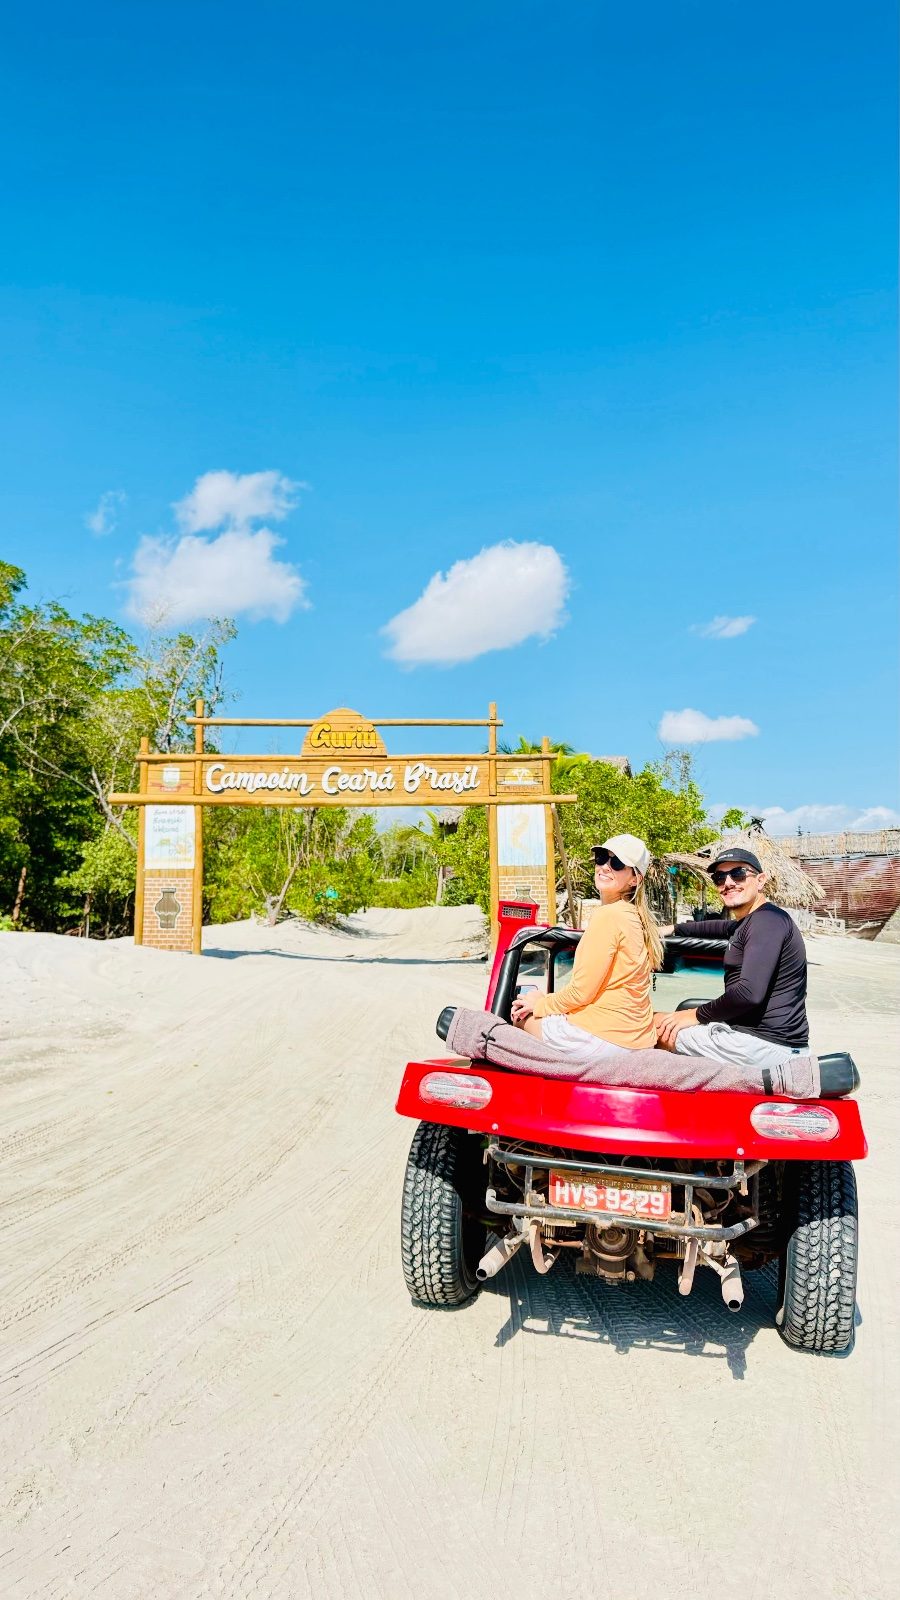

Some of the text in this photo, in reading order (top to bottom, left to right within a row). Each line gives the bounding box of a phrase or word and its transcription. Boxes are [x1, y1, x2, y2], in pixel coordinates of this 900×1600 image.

[310, 722, 378, 749] Guriú
[205, 762, 480, 795] Camocim Ceará Brasil
